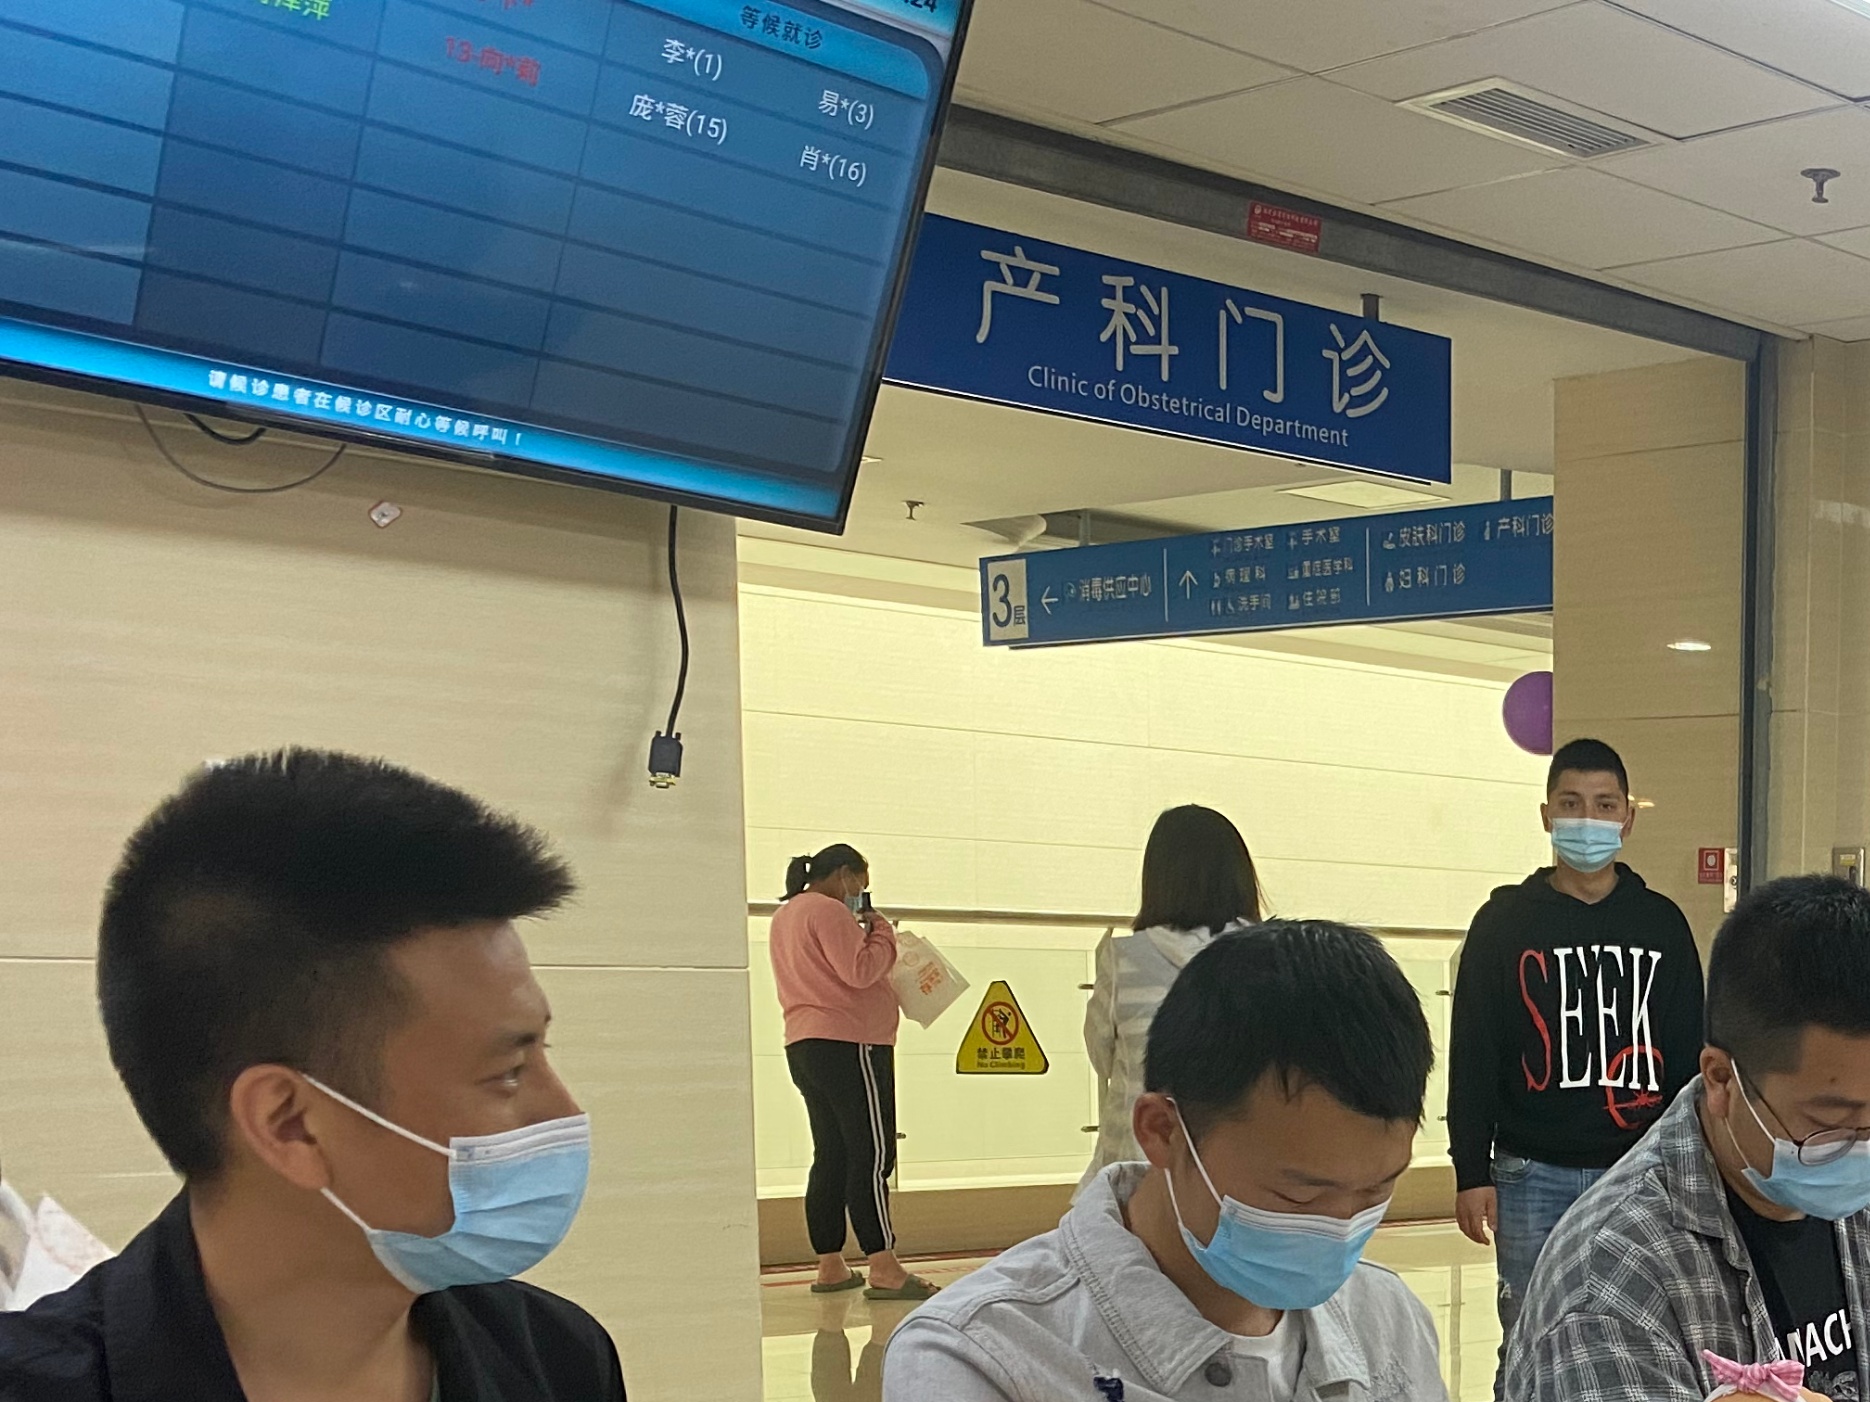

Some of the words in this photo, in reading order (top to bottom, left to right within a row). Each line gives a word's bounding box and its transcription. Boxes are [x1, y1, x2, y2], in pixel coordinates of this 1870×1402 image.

[739, 5, 824, 50] 等候就诊
[976, 245, 1390, 418] 产科门诊
[1028, 365, 1088, 397] Clinic
[1095, 379, 1115, 400] of
[1120, 383, 1231, 425] Obstetrical
[1237, 406, 1349, 447] Department
[1399, 520, 1466, 548] 皮肤科门诊
[992, 573, 1026, 628] 3层
[1398, 562, 1466, 590] 妇科门诊
[1518, 944, 1663, 1093] SEEK
